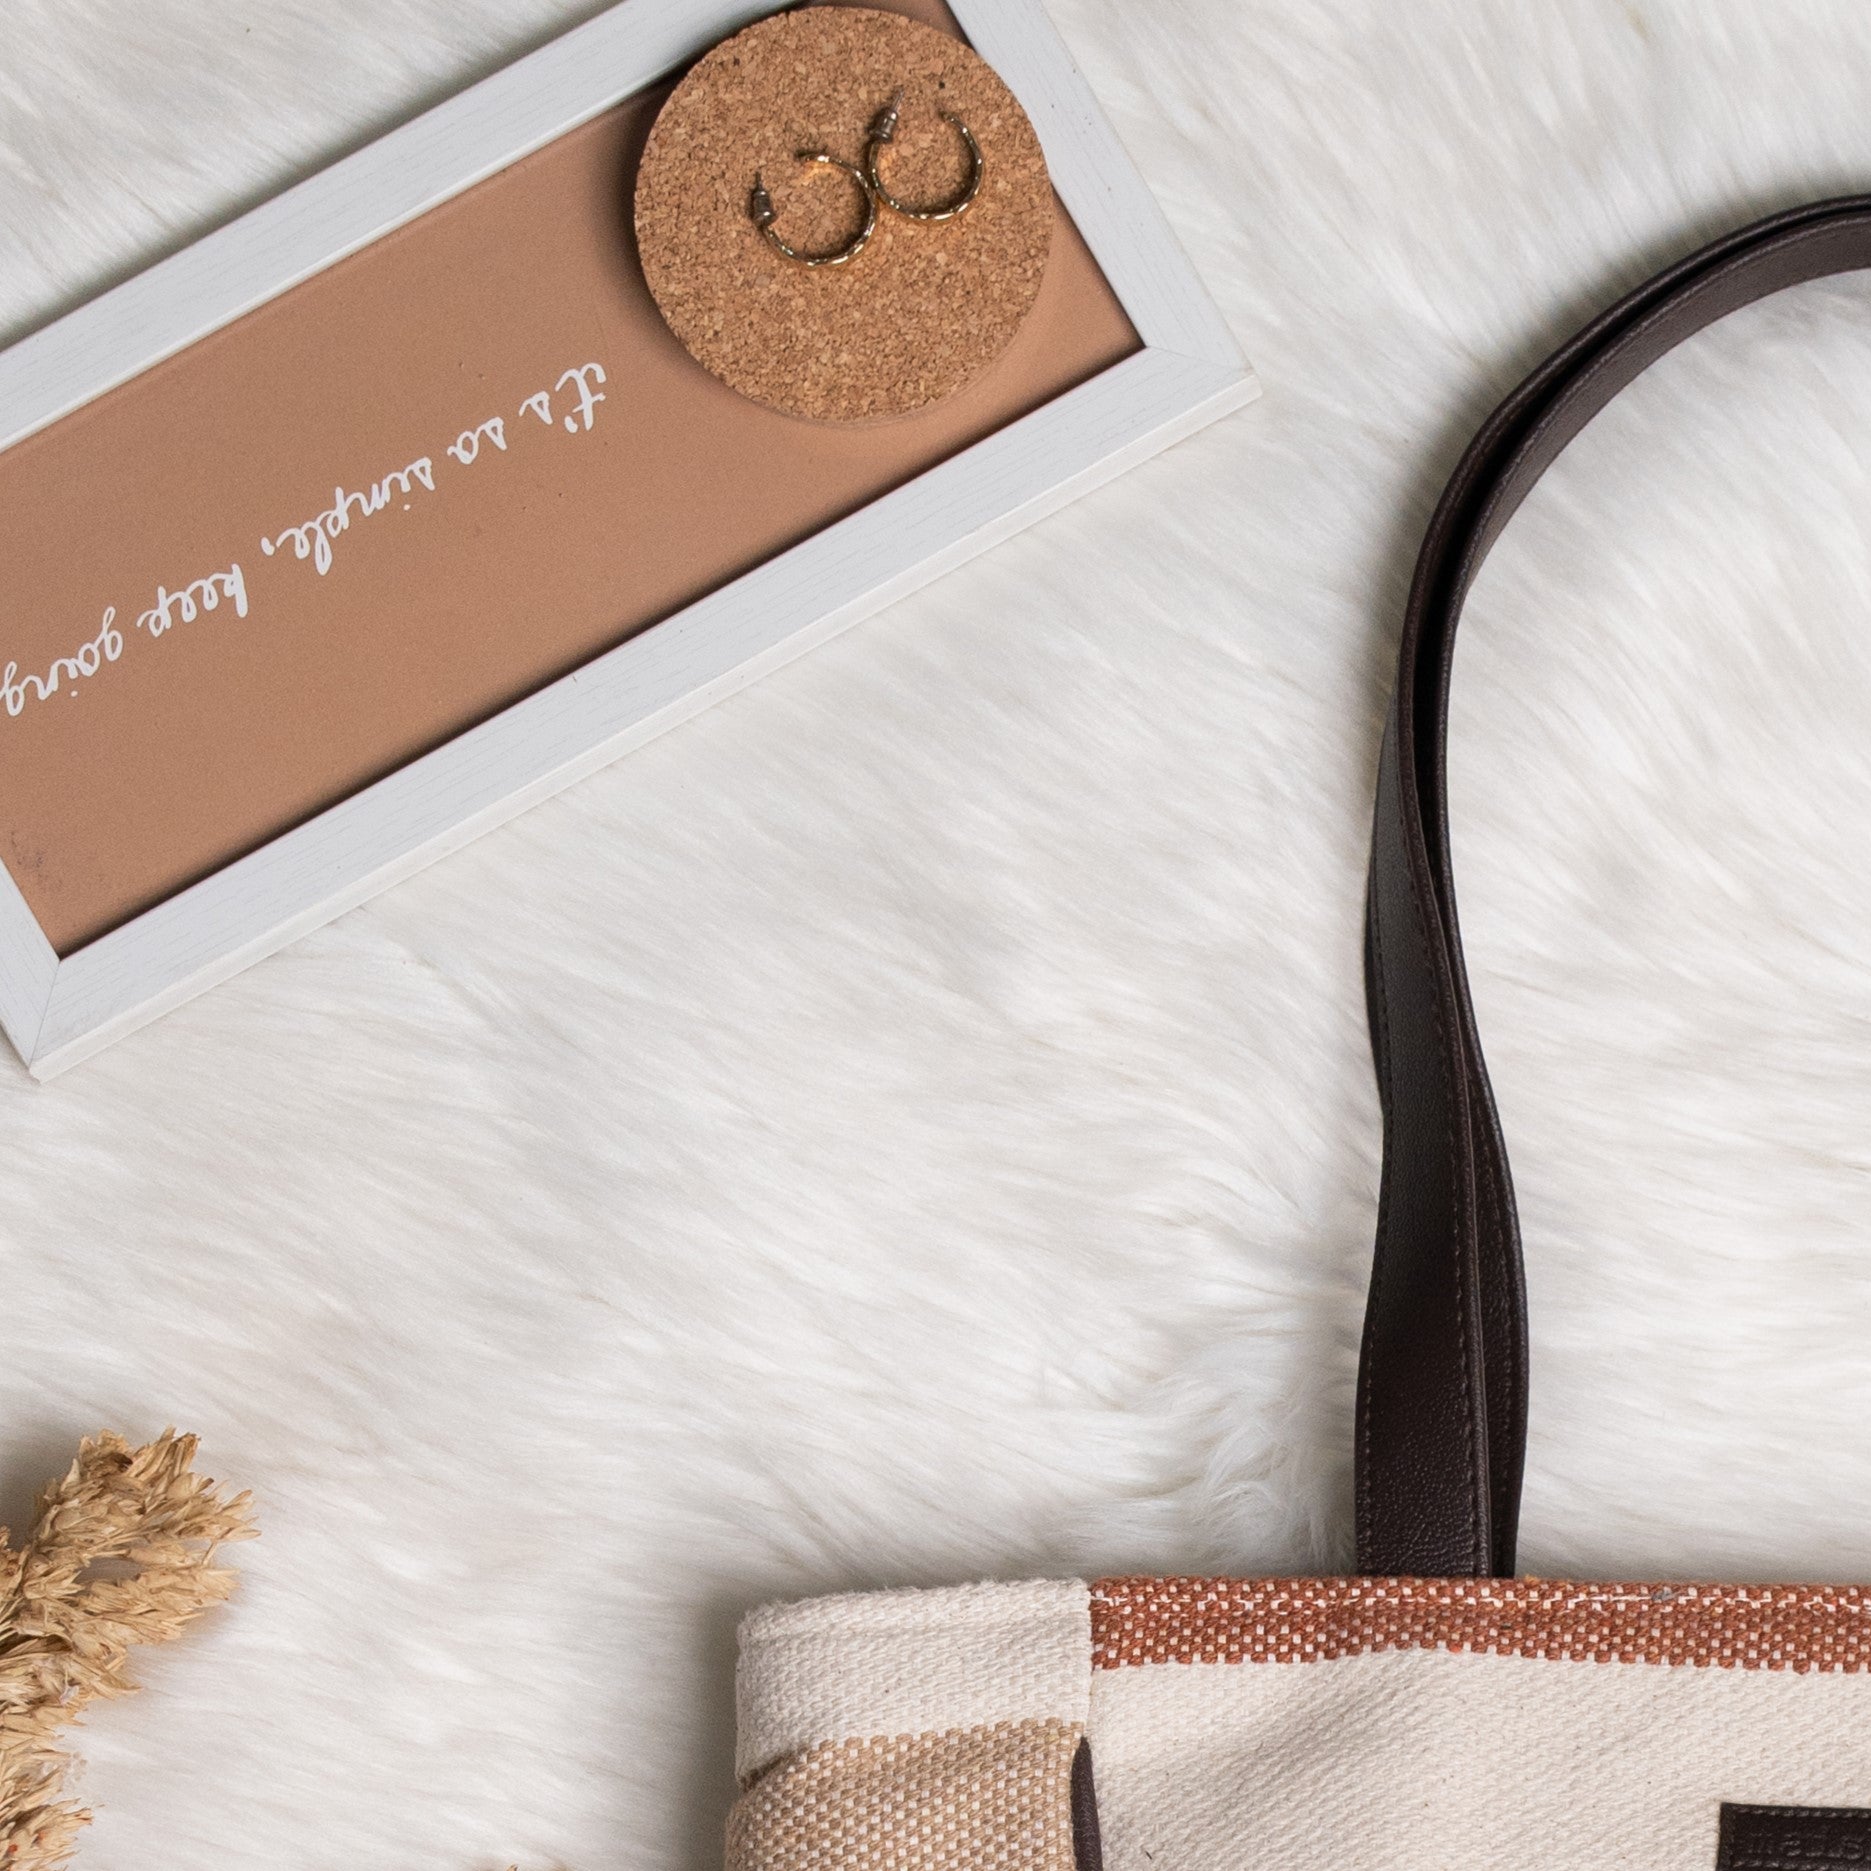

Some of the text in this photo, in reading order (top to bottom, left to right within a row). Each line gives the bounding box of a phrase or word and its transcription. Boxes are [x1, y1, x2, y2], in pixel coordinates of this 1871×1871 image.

[0, 363, 606, 716] it's so simple, keep going
